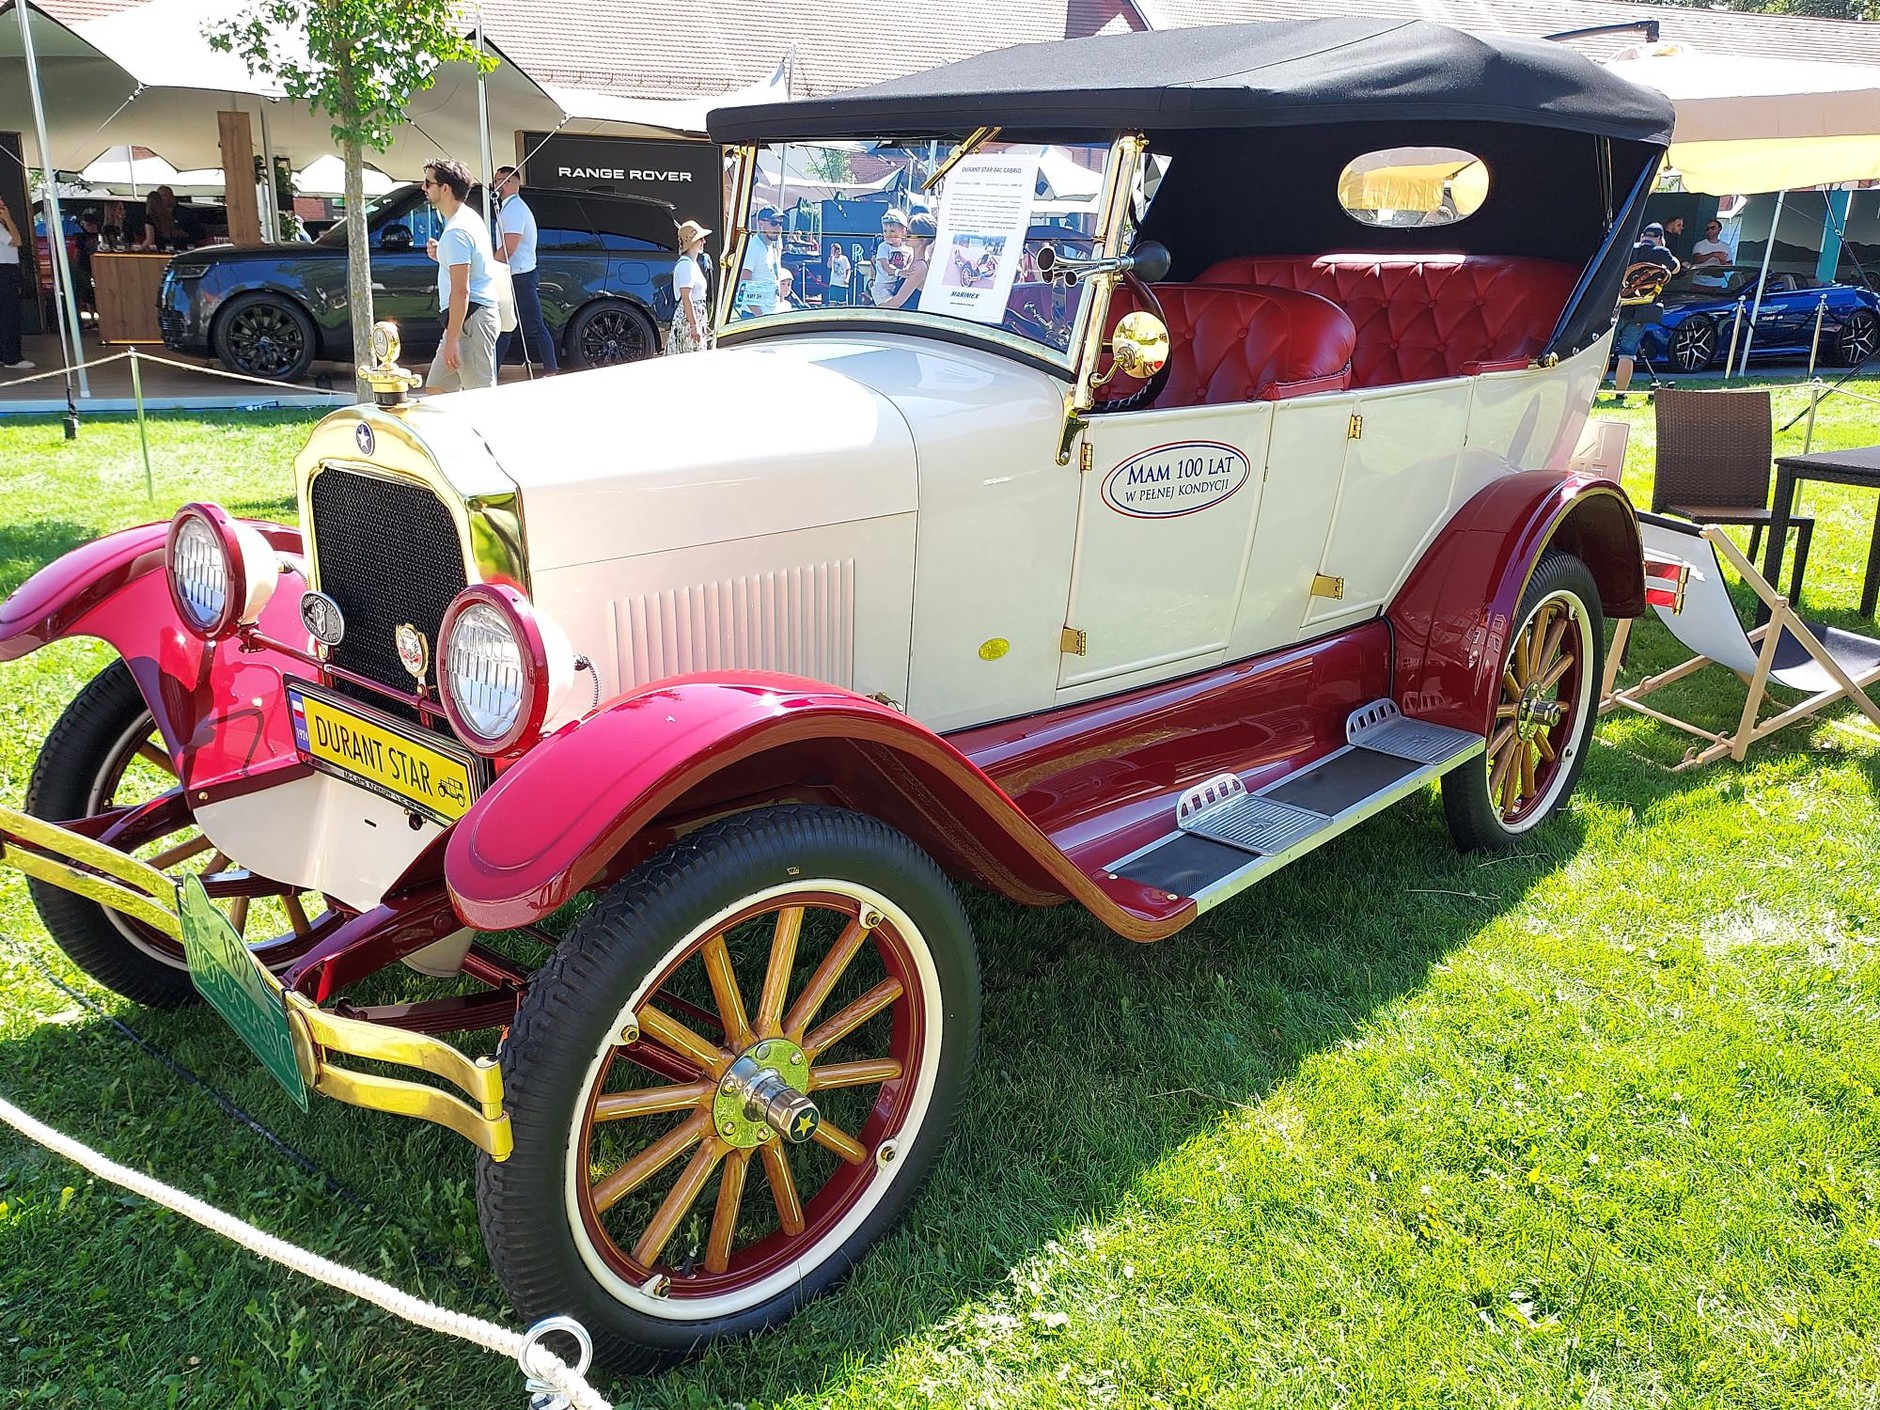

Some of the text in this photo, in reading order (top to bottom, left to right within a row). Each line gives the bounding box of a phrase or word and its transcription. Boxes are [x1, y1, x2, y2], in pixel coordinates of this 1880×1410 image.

[558, 166, 693, 183] RANGE ROVER
[950, 290, 980, 300] MARIMEX
[1126, 456, 1235, 485] MAM 100 LAT
[1125, 478, 1229, 503] W PEŁNEJ KONDYCJI
[296, 727, 309, 742] 1924
[315, 714, 434, 797] DURANT STAR
